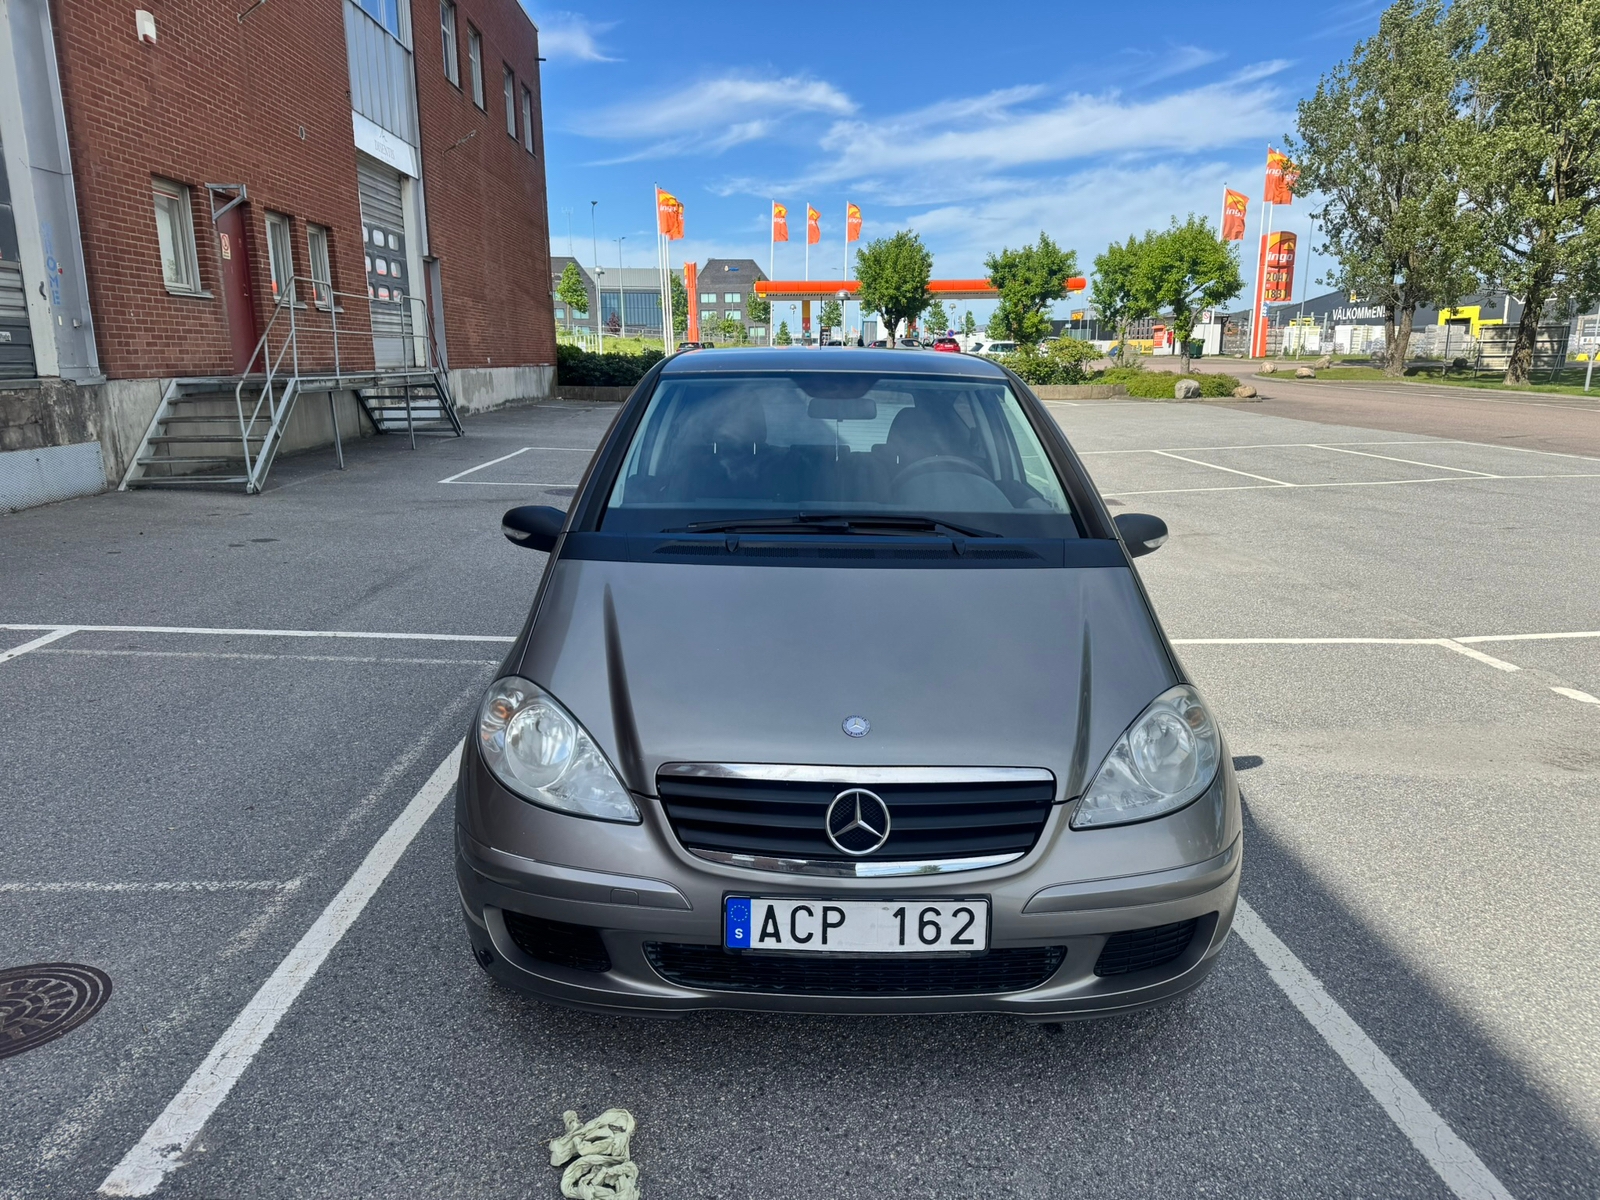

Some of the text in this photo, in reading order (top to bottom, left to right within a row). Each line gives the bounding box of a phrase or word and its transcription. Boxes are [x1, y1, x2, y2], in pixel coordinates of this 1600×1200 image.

[1266, 167, 1282, 177] ing
[1267, 252, 1293, 262] ingo
[1333, 306, 1386, 320] VÄLKOMMEN!
[758, 904, 976, 946] ACP 162
[734, 928, 744, 939] S
